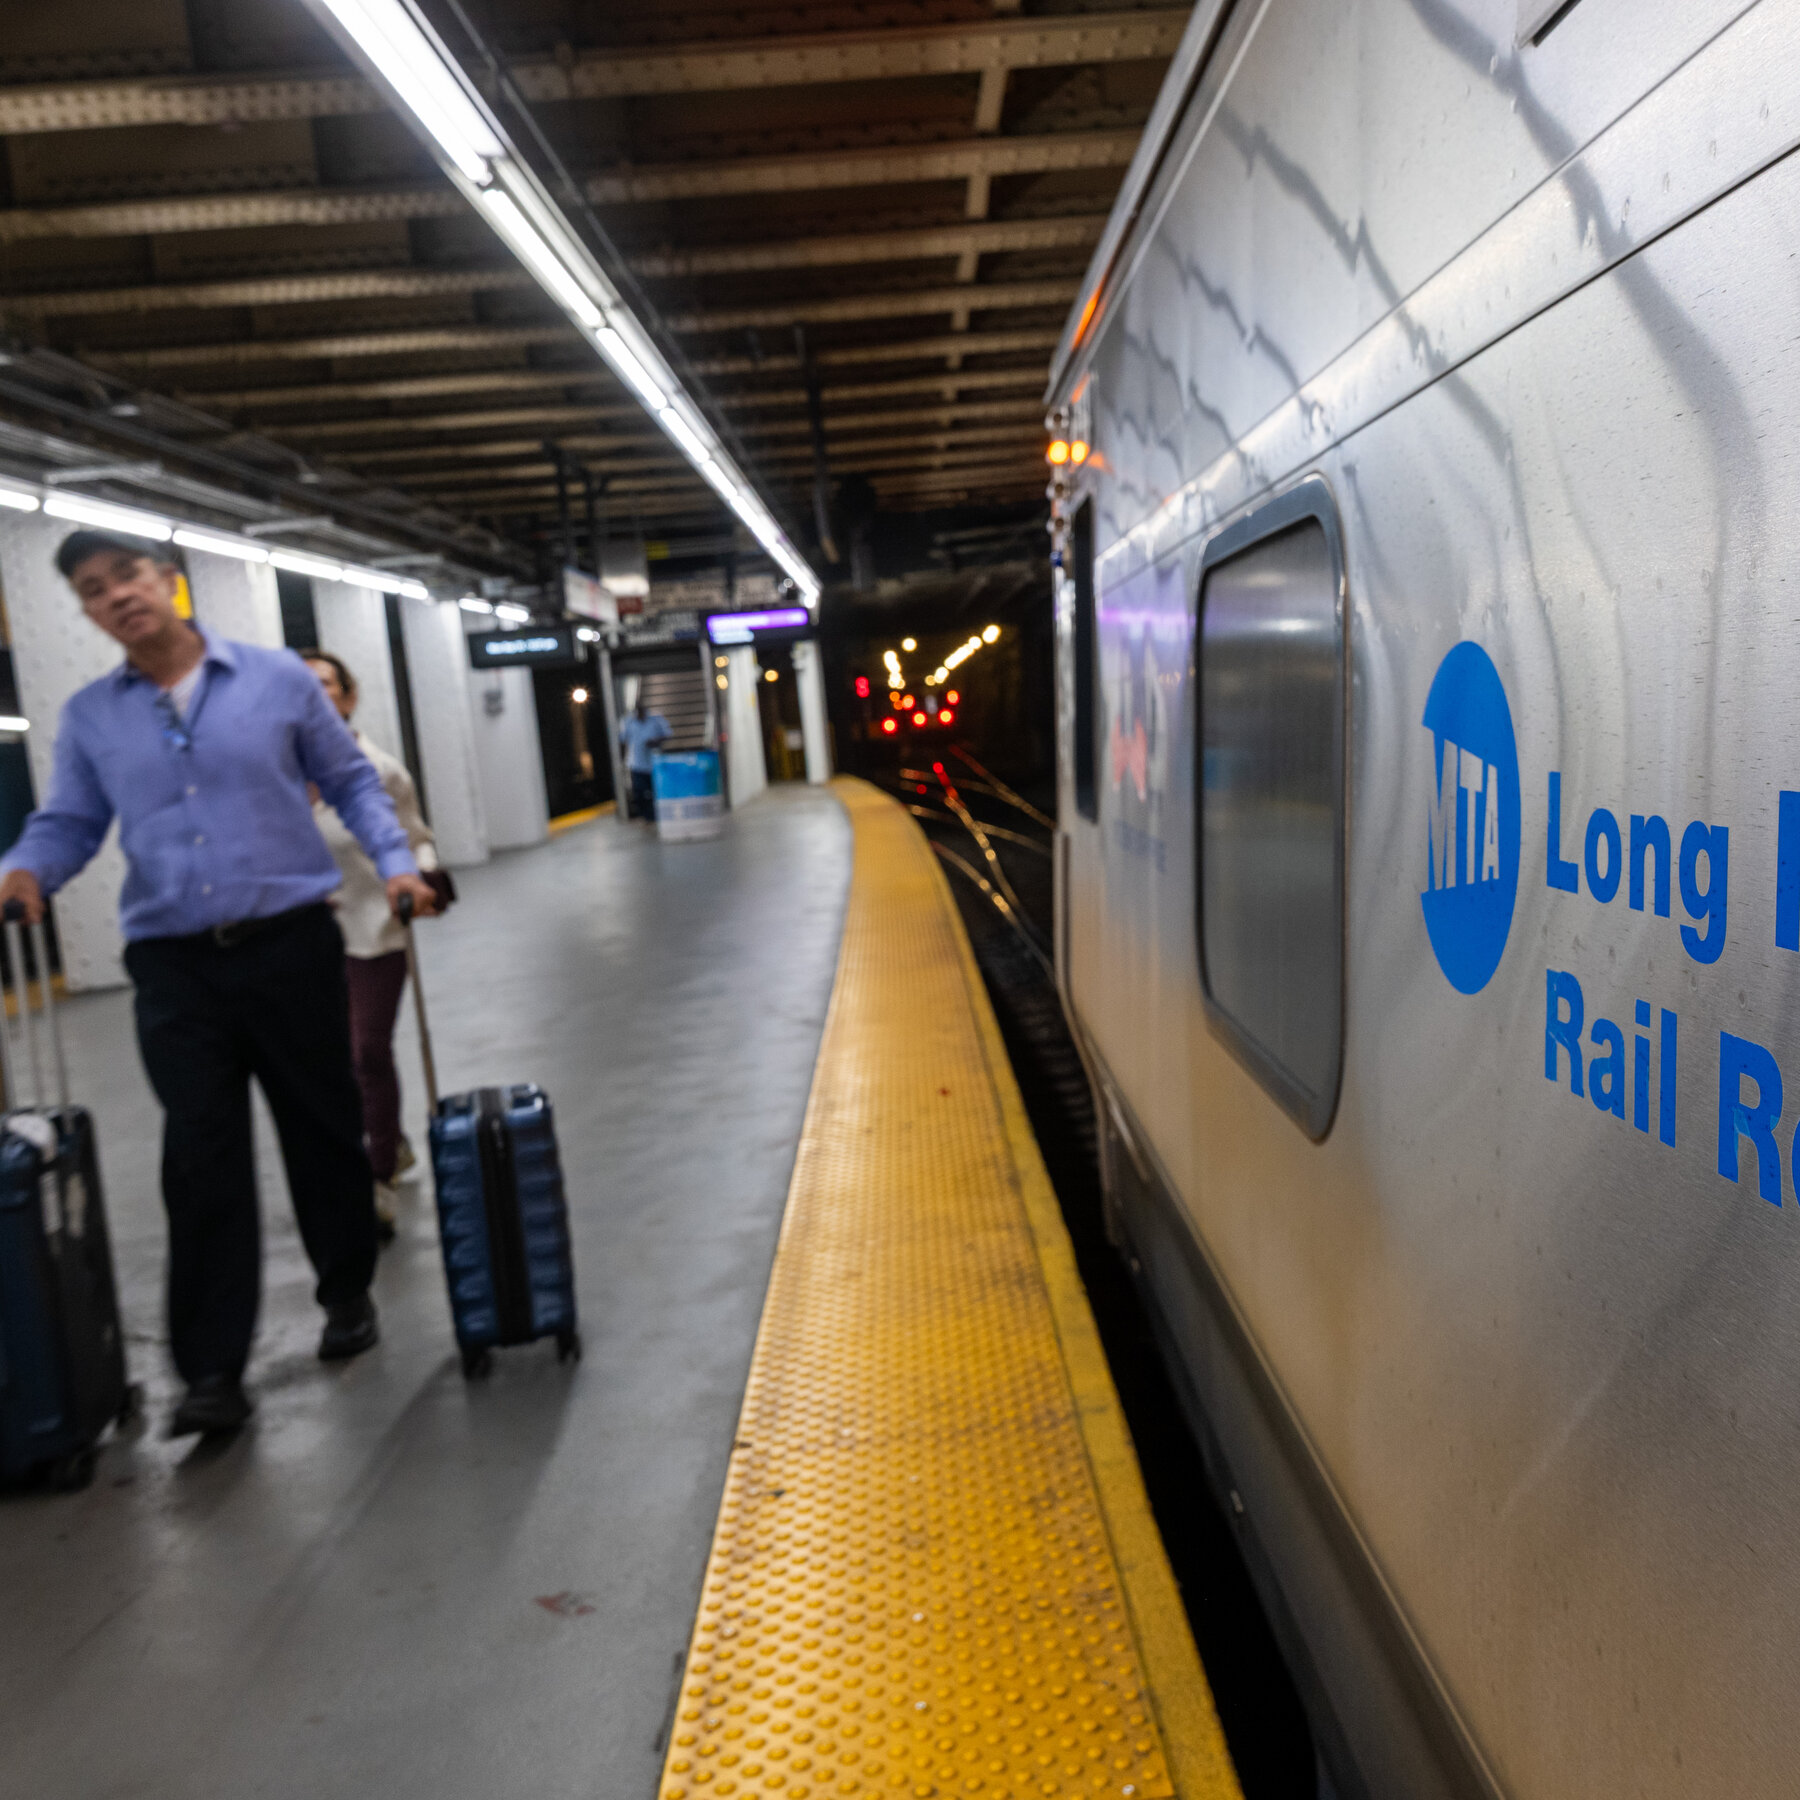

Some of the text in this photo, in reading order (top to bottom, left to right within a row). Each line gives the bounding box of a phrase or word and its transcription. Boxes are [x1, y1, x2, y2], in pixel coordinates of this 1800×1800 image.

[1424, 726, 1500, 893] MTA
[1546, 770, 1730, 965] Long
[1544, 968, 1800, 1209] Rail R
